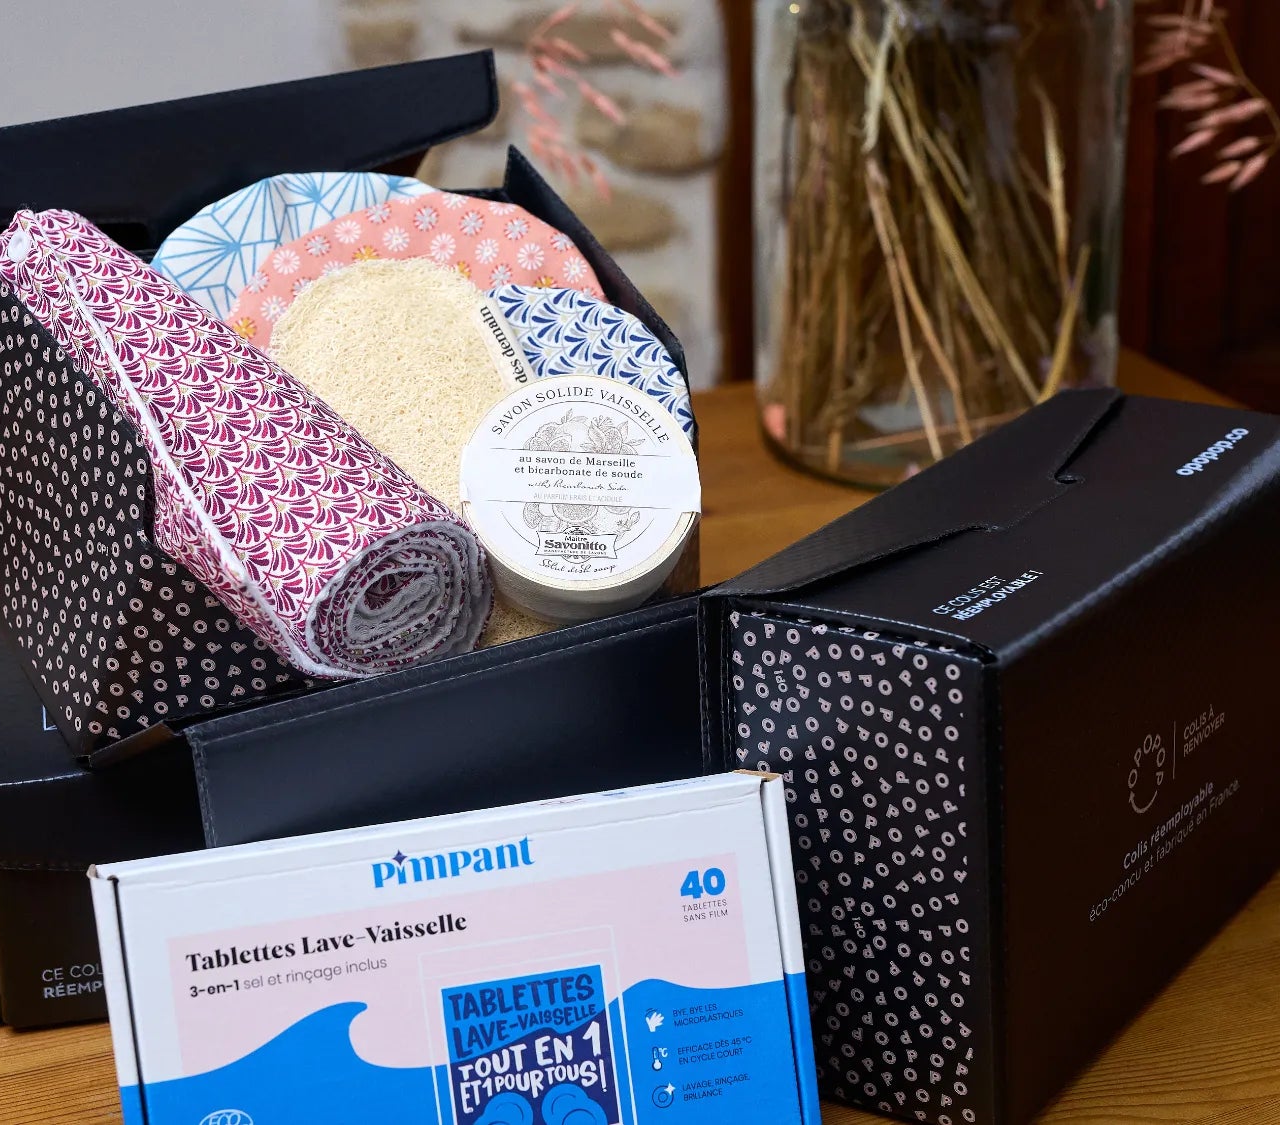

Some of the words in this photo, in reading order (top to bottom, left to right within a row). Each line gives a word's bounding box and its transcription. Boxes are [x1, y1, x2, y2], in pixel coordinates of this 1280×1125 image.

[480, 306, 517, 359] demain
[507, 356, 528, 384] dès
[491, 398, 533, 435] SAVON
[536, 386, 594, 403] SOLIDE
[600, 389, 670, 444] VAISSELLE
[514, 466, 525, 474] et
[528, 465, 592, 477] bicarbonate
[595, 468, 608, 478] de
[611, 470, 643, 479] soude
[535, 456, 566, 464] savon
[569, 456, 582, 465] de
[586, 457, 636, 468] Marseille
[1175, 427, 1250, 476] opopop.co
[544, 539, 607, 551] Savonitto
[932, 604, 956, 615] CE
[1183, 711, 1207, 740] COLIS
[1183, 713, 1225, 757] RENVOYER
[1123, 840, 1148, 869] Colis
[1150, 781, 1214, 846] réemployable
[1144, 854, 1154, 873] et
[1196, 807, 1207, 825] en
[371, 835, 536, 888] Pimpant
[680, 867, 726, 899] 40
[682, 899, 728, 912] TABLETTES
[683, 912, 706, 923] SANS
[709, 909, 729, 919] FILM
[185, 940, 296, 972] Tablettes
[302, 913, 468, 956] Lave-Vaisselle
[42, 968, 64, 983] CE
[189, 980, 240, 998] 3-en-1
[243, 975, 264, 990] sel
[267, 973, 283, 986] et
[286, 964, 343, 984] rinçage
[345, 957, 388, 974] inclus
[448, 973, 595, 1021] TABLETTES
[452, 1003, 597, 1058] LAVE-VAISSELLE
[458, 1043, 528, 1081] TOUT
[535, 1035, 573, 1067] EN
[583, 1020, 601, 1057] 1
